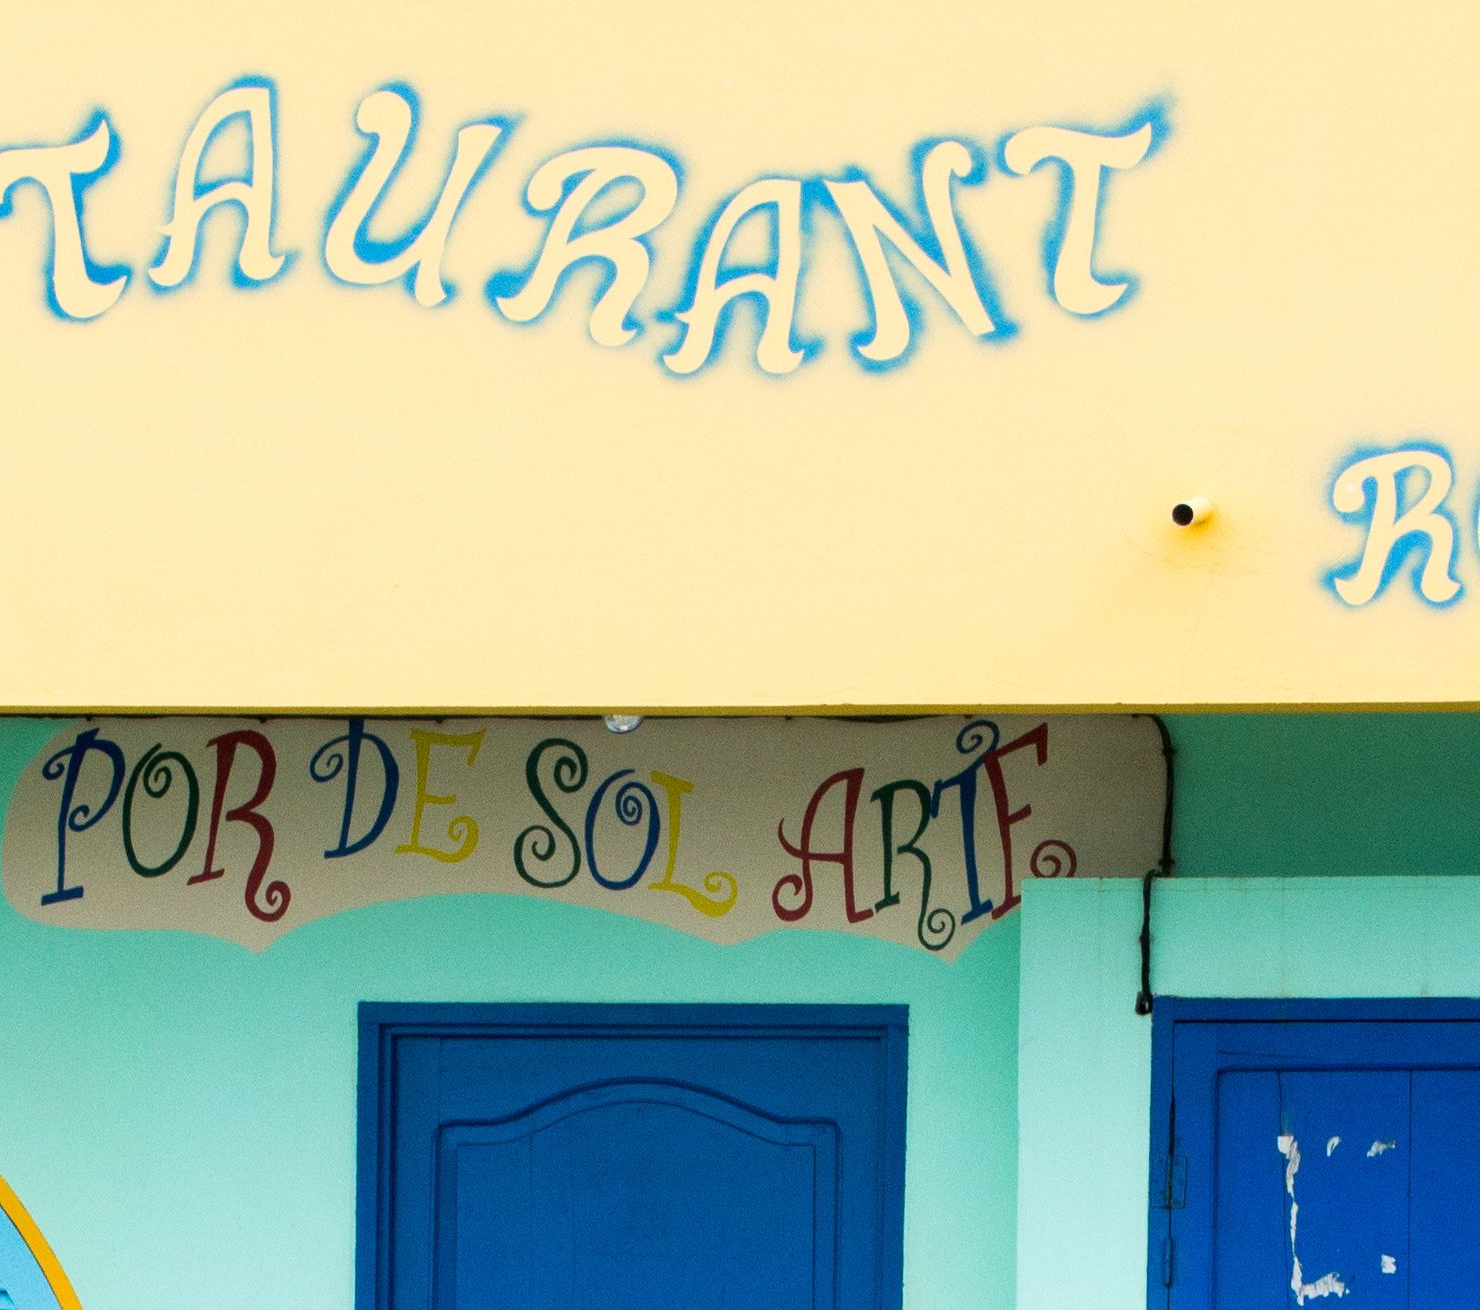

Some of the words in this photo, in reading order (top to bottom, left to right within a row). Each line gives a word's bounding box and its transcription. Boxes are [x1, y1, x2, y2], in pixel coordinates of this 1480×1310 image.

[40, 728, 292, 923] POR
[309, 719, 487, 864] DE
[514, 737, 738, 917] SOL
